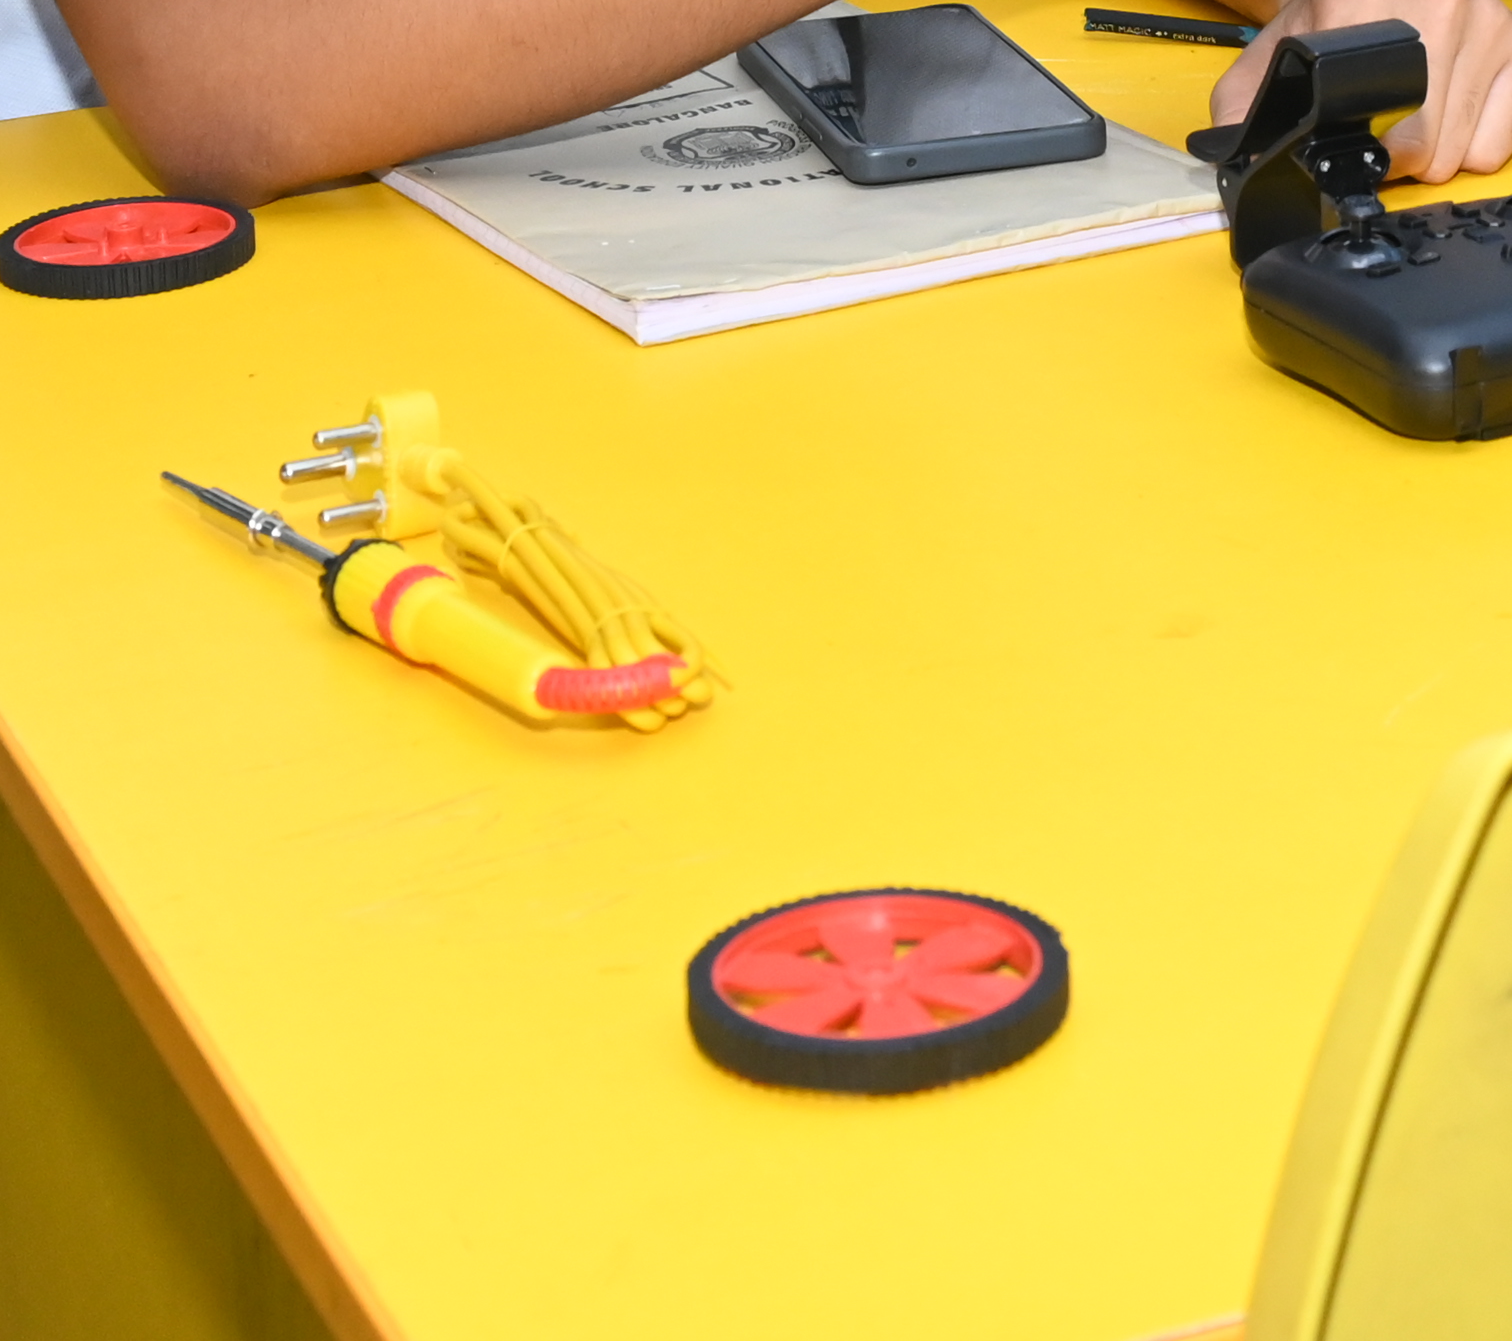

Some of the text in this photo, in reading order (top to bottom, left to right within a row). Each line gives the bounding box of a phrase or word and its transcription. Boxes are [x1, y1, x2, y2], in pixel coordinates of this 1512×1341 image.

[1089, 22, 1217, 44] MATT MAGIC extra dark
[596, 99, 753, 132] BANGALORE
[528, 168, 842, 193] ATIONAL SCHOOL
